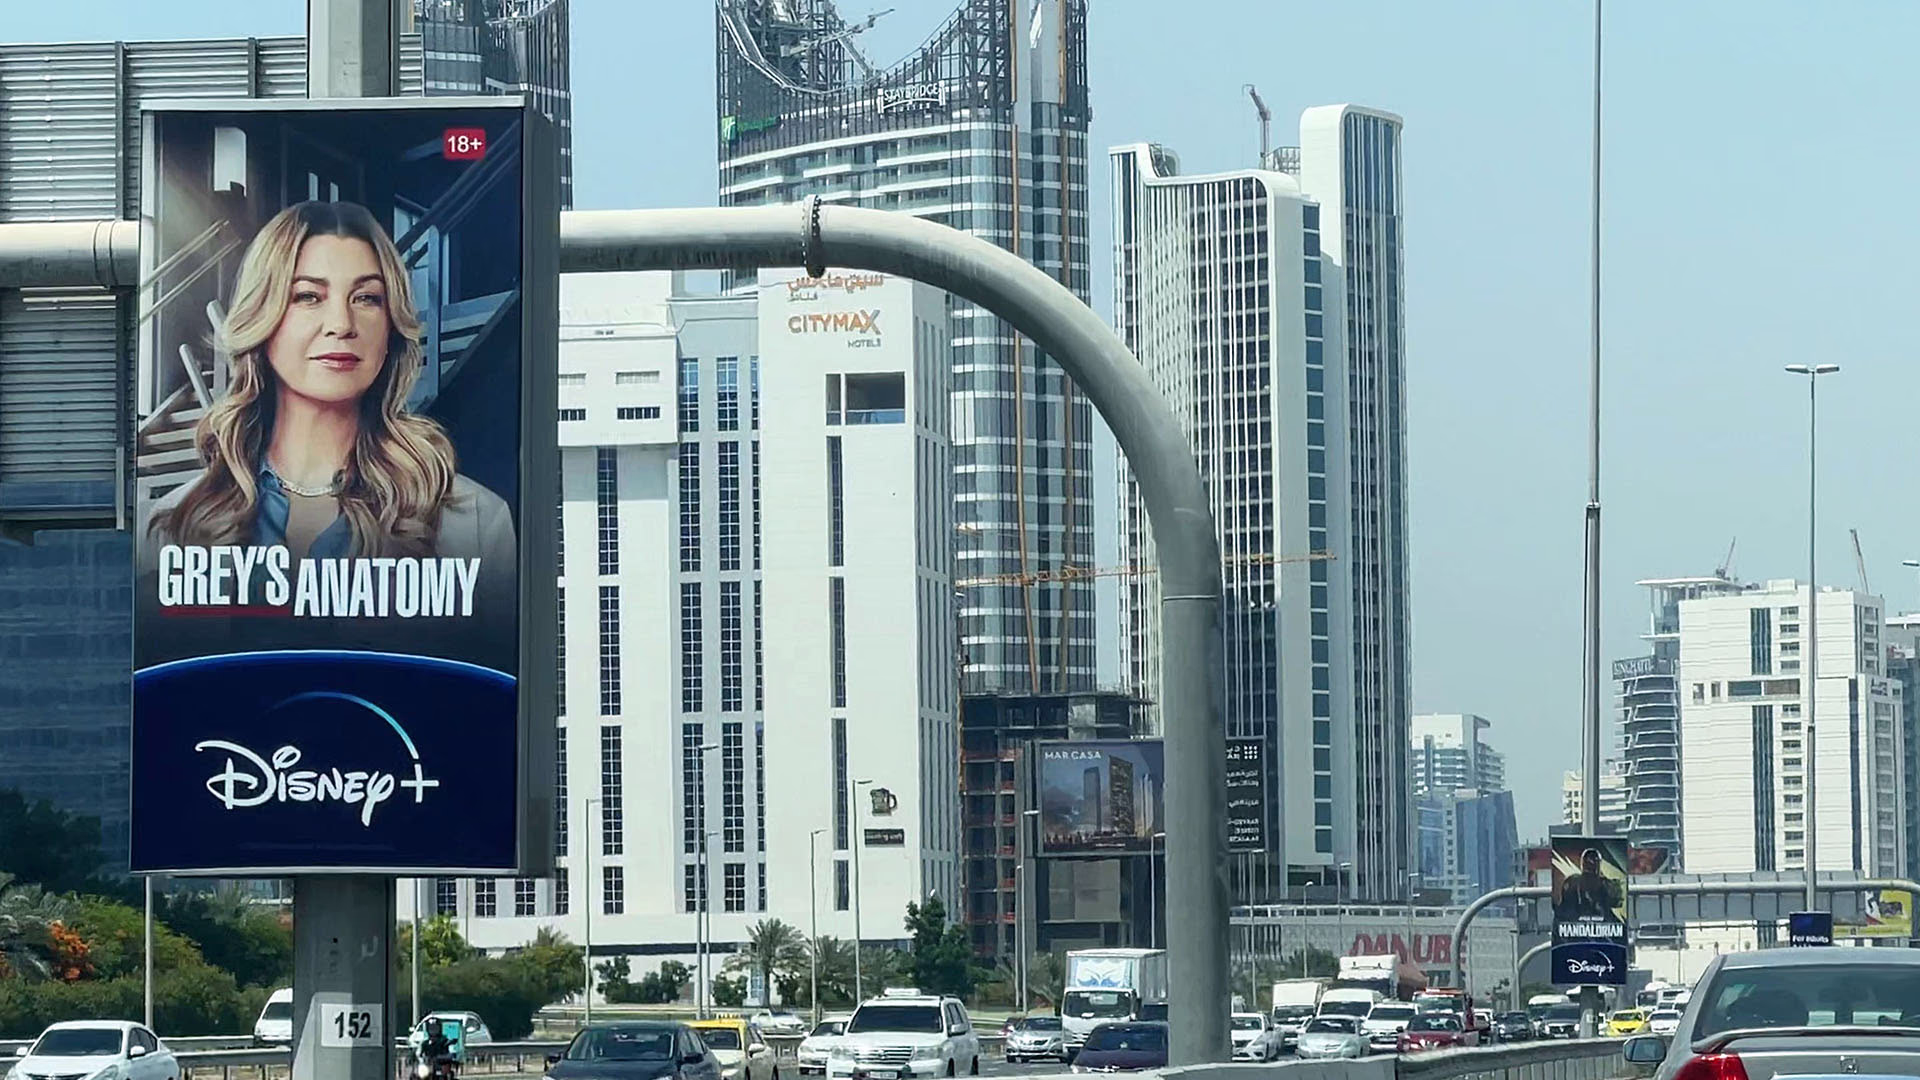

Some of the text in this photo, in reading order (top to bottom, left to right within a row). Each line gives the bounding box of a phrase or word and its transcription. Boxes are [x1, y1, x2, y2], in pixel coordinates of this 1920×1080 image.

[448, 135, 482, 152] 18+
[788, 309, 881, 335] CITYMAX
[158, 545, 482, 618] GREY'S ANATOMY
[1044, 751, 1102, 760] MAR CASA
[1559, 924, 1623, 937] MANDALORIAN
[1349, 932, 1467, 963] DANUB
[334, 1012, 371, 1038] 152
